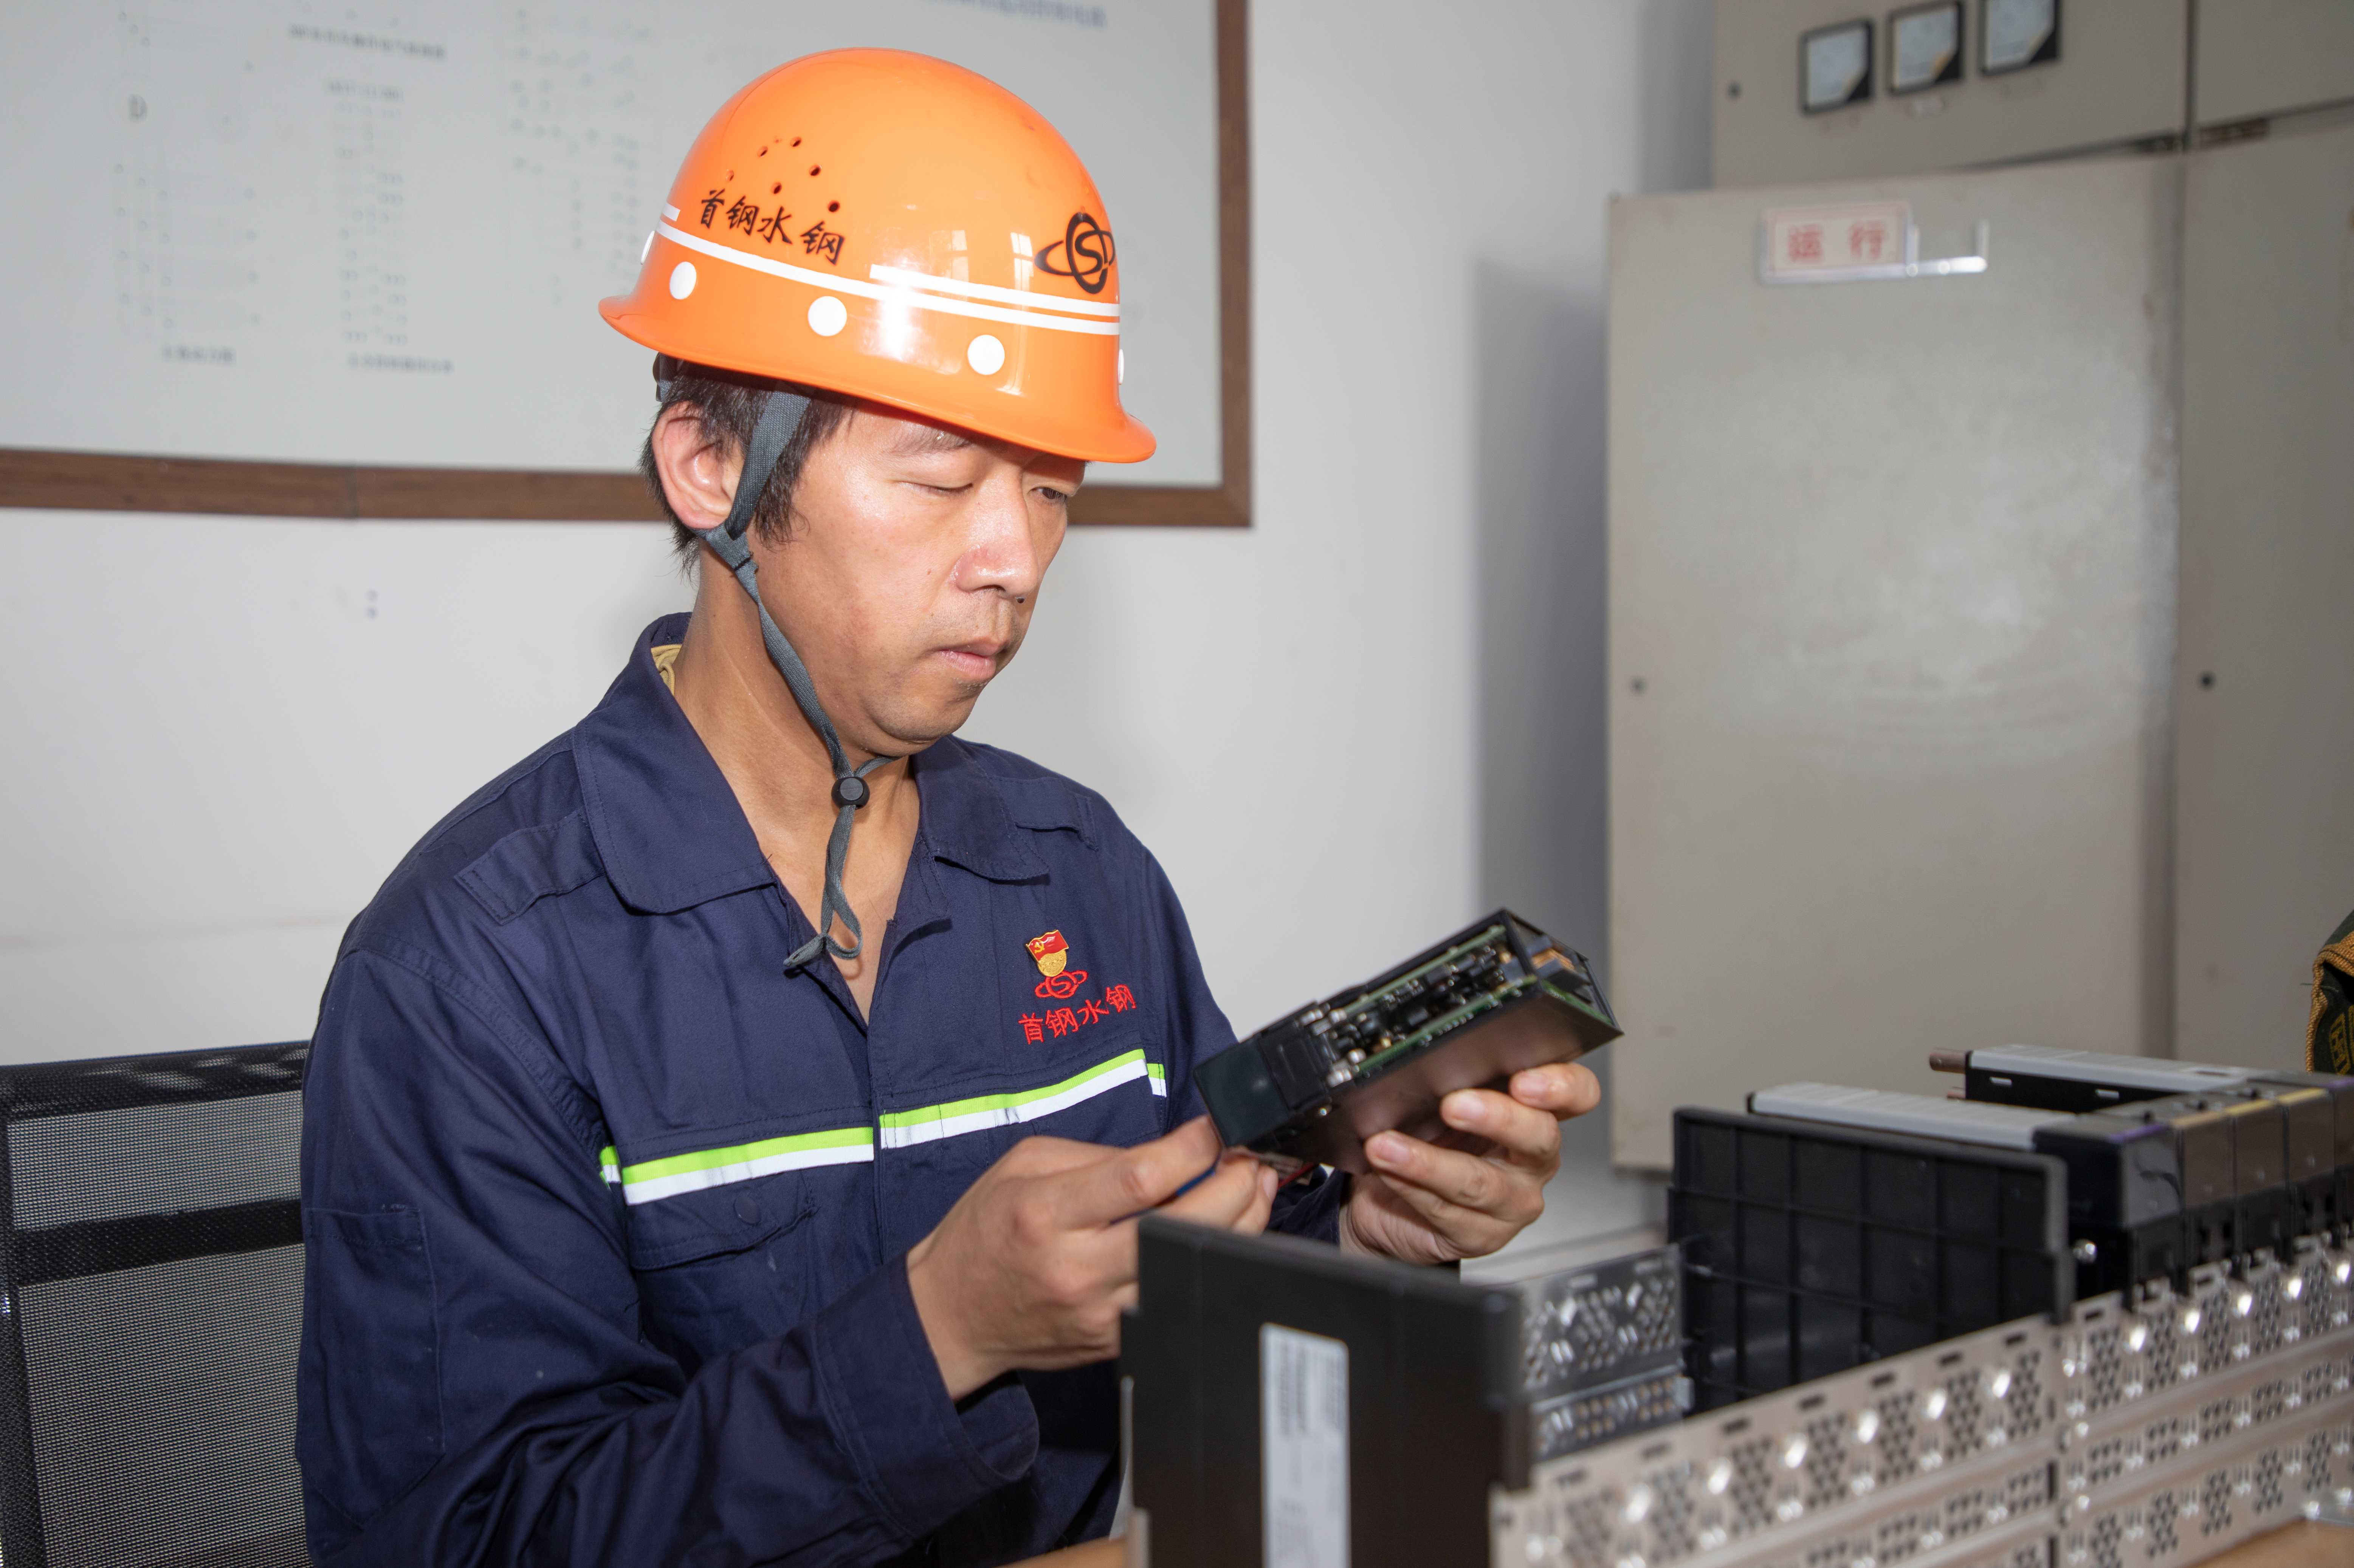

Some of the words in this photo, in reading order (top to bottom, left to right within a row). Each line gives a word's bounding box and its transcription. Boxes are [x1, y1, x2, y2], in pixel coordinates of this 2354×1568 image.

[700, 188, 845, 266] 首钢水钢
[1787, 221, 1886, 263] 运行
[1018, 984, 1137, 1045] 首钢水钢
